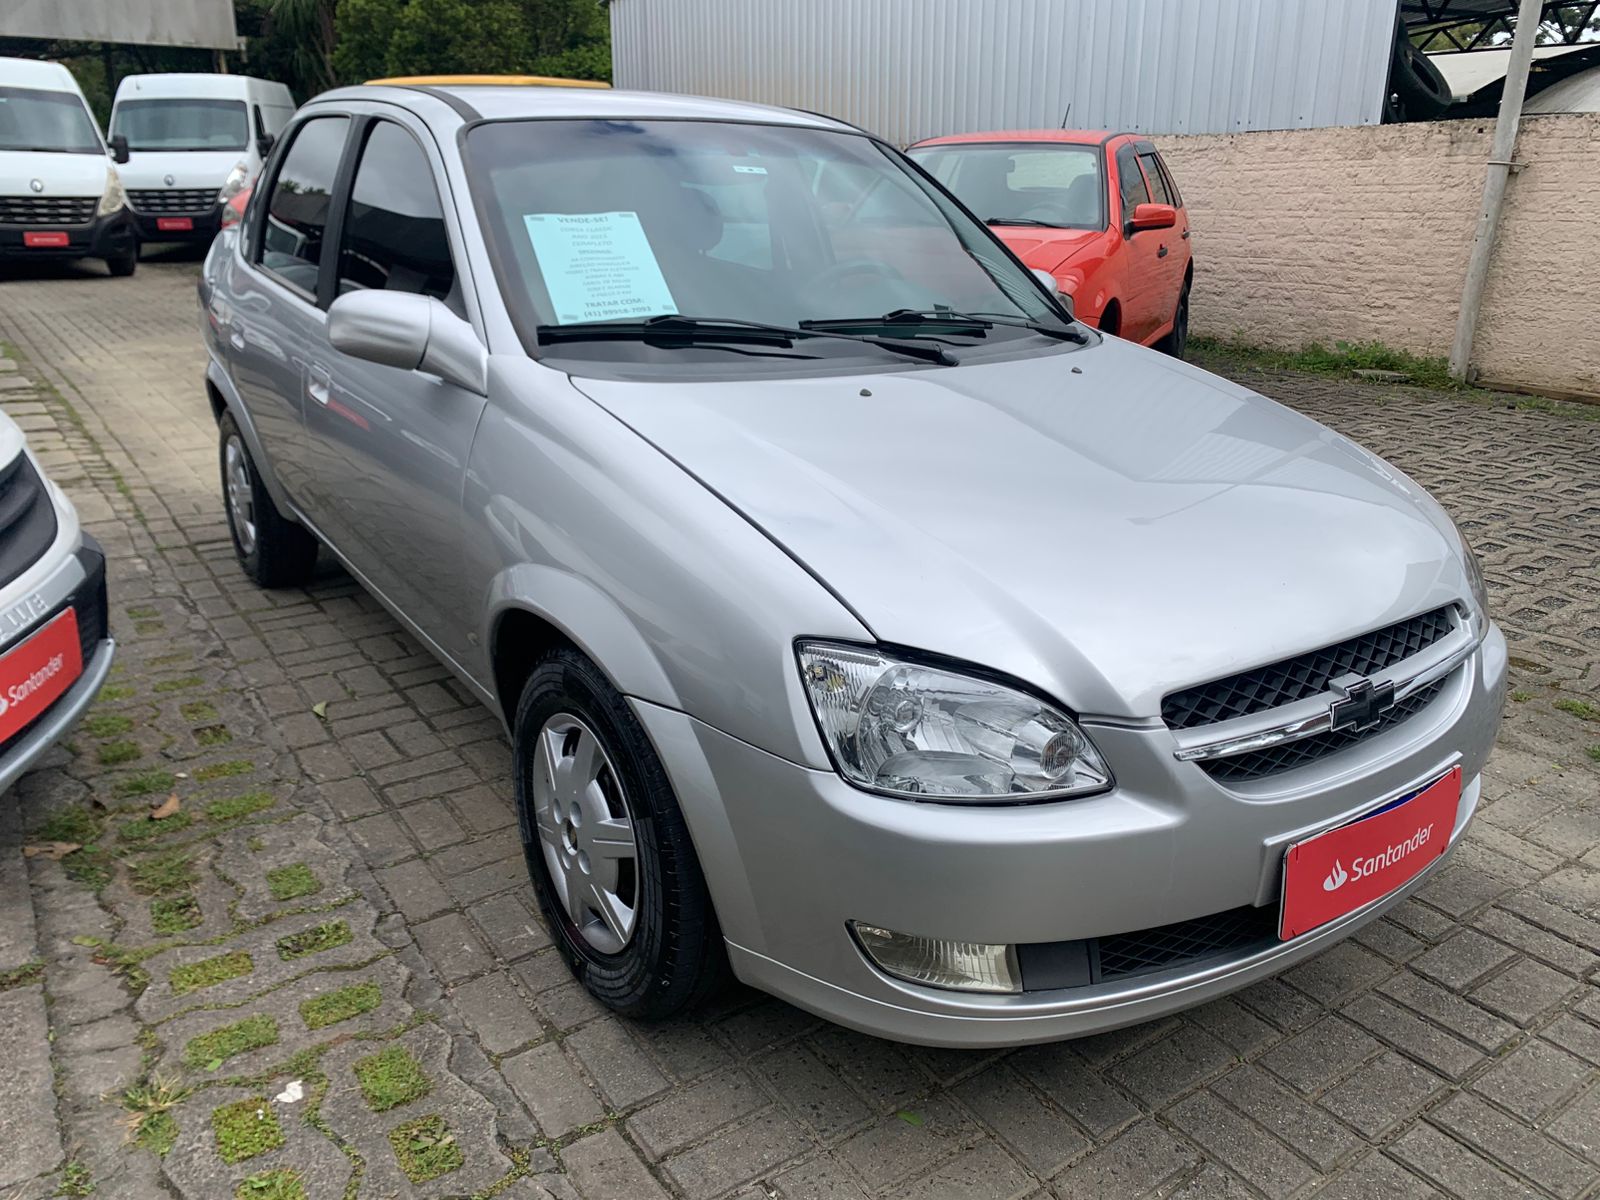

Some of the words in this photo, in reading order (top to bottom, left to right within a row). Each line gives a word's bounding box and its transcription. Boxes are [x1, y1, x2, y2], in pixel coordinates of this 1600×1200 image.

[557, 215, 609, 223] VENDE-SE!
[8, 653, 63, 706] Santander
[1351, 823, 1433, 881] Santander
